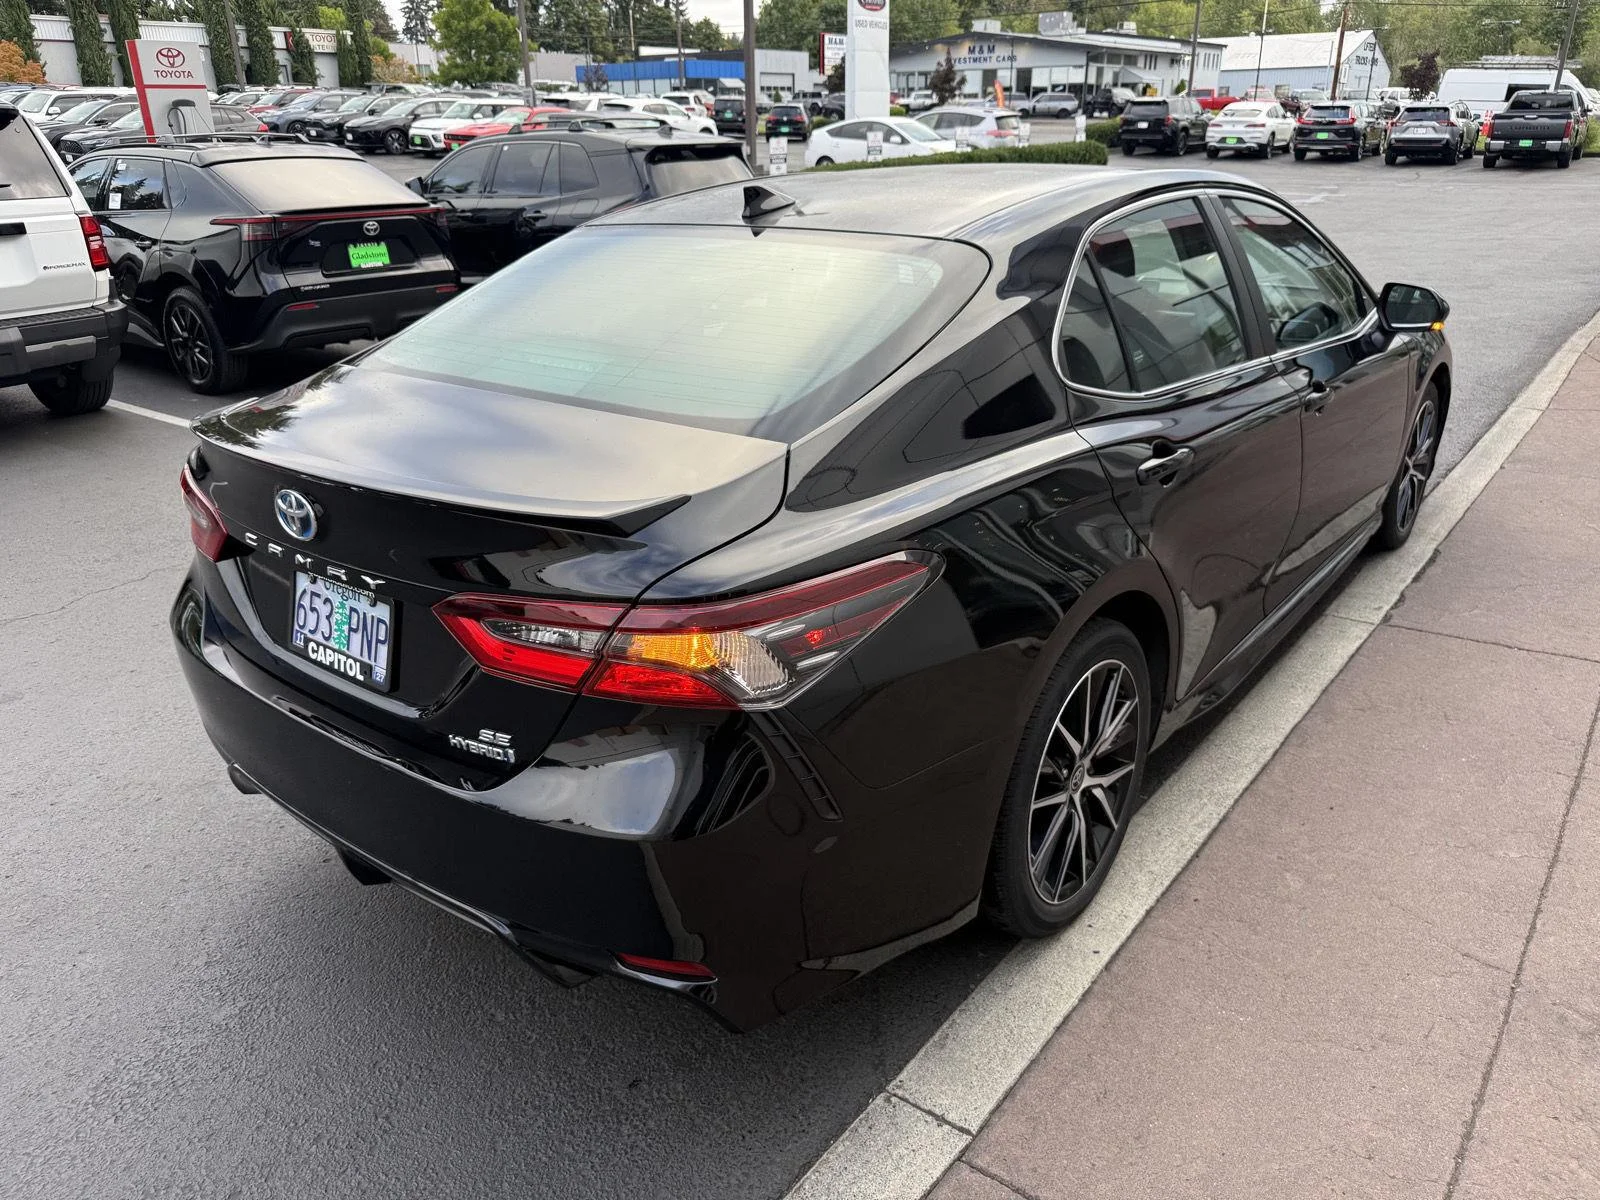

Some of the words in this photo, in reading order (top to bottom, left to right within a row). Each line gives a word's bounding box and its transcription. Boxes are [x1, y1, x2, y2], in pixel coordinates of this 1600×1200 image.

[310, 34, 336, 43] TOYOT
[952, 56, 993, 65] VESTMENT
[153, 70, 194, 79] TOYOTA
[244, 532, 386, 590] CAMRY
[296, 587, 334, 642] 653
[346, 606, 389, 664] PNP
[308, 641, 365, 682] CAPITOL
[448, 734, 505, 761] HYBRID
[478, 728, 513, 746] SE
